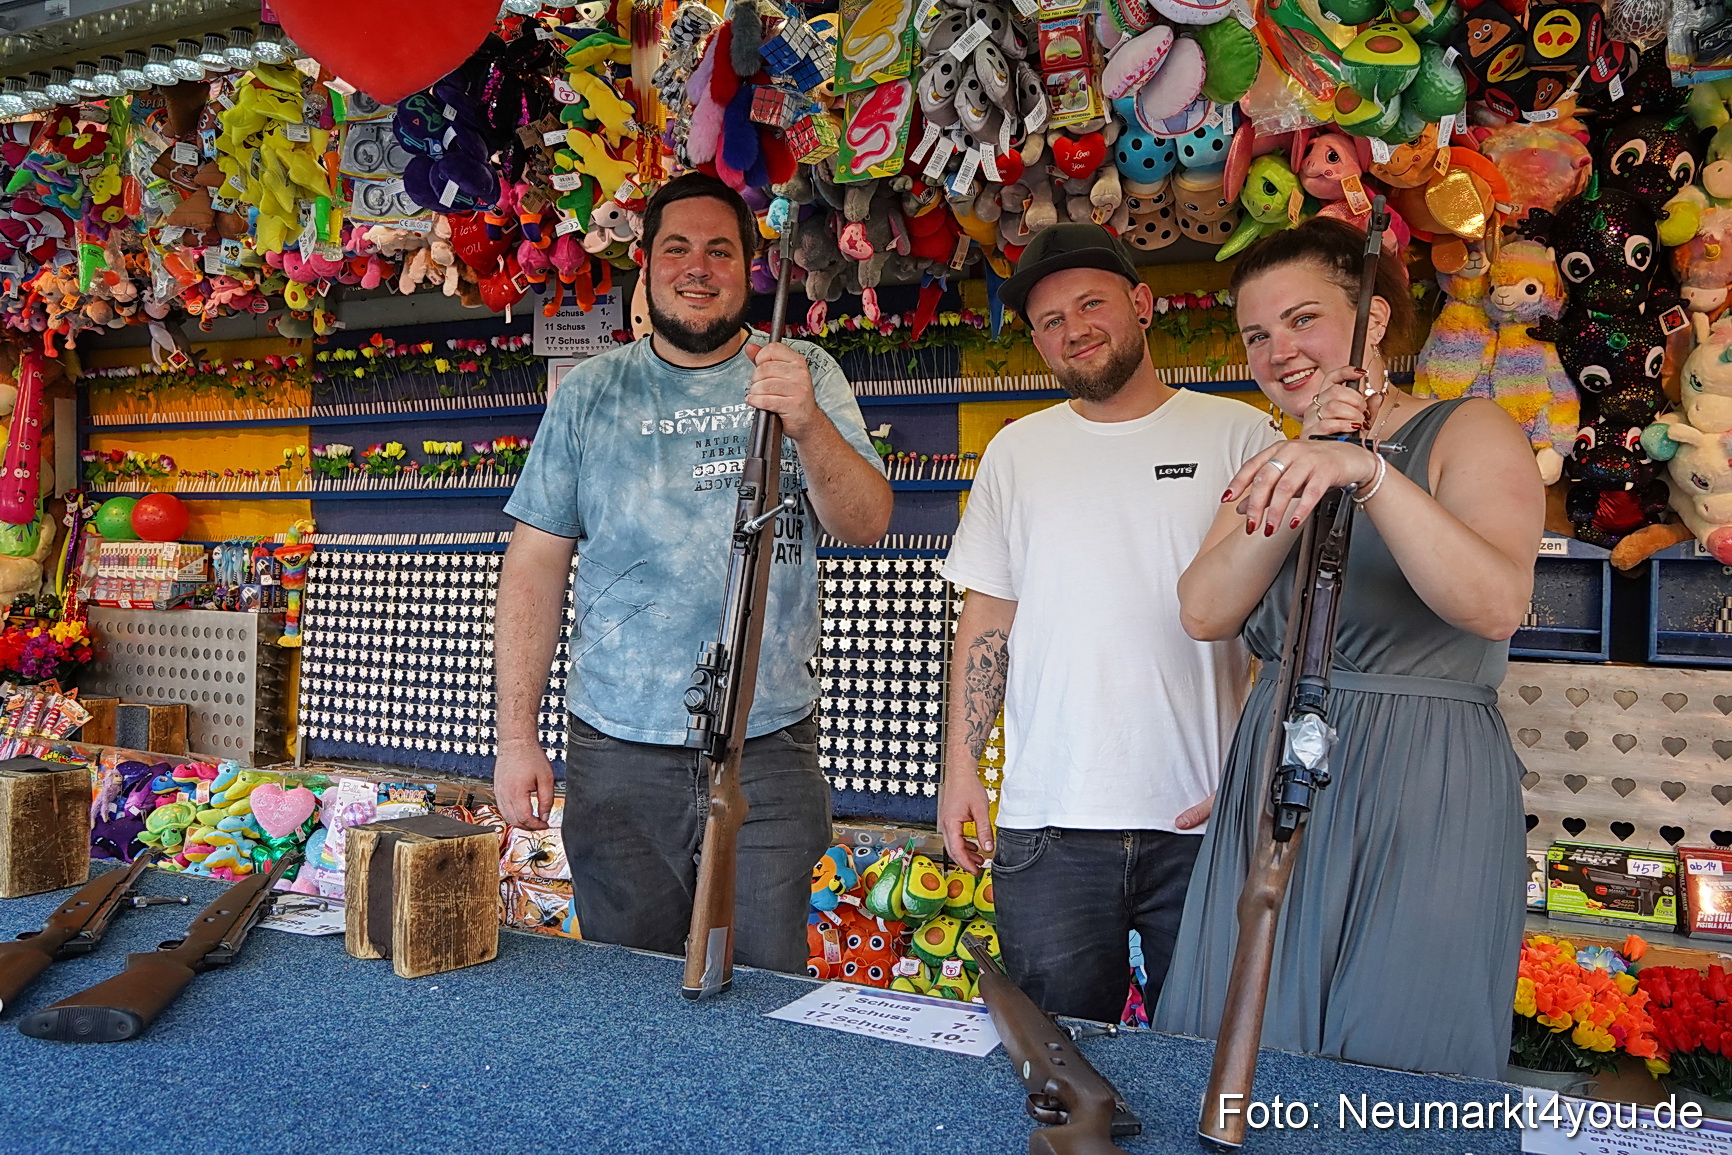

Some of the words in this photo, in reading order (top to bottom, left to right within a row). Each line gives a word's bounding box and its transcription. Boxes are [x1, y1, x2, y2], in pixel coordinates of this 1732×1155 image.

[545, 323, 554, 331] 11
[557, 322, 586, 331] Schuss
[545, 336, 556, 345] 17
[558, 336, 590, 345] Schuss
[388, 788, 427, 803] POLICE
[1690, 862, 1702, 871] ab
[1703, 861, 1717, 872] 14
[854, 997, 922, 1012] Schuss
[820, 1002, 841, 1010] 11
[843, 1006, 912, 1022] Schuss
[951, 1022, 980, 1032] 7,-
[805, 1010, 831, 1018] 17
[832, 1015, 909, 1034] Schuss
[929, 1031, 977, 1044] 10,-
[1590, 1136, 1639, 1149] erhält
[1613, 1132, 1649, 1143] vom
[1654, 1139, 1715, 1154] Podest
[1701, 1142, 1728, 1150] die
[1598, 1146, 1610, 1154] 3
